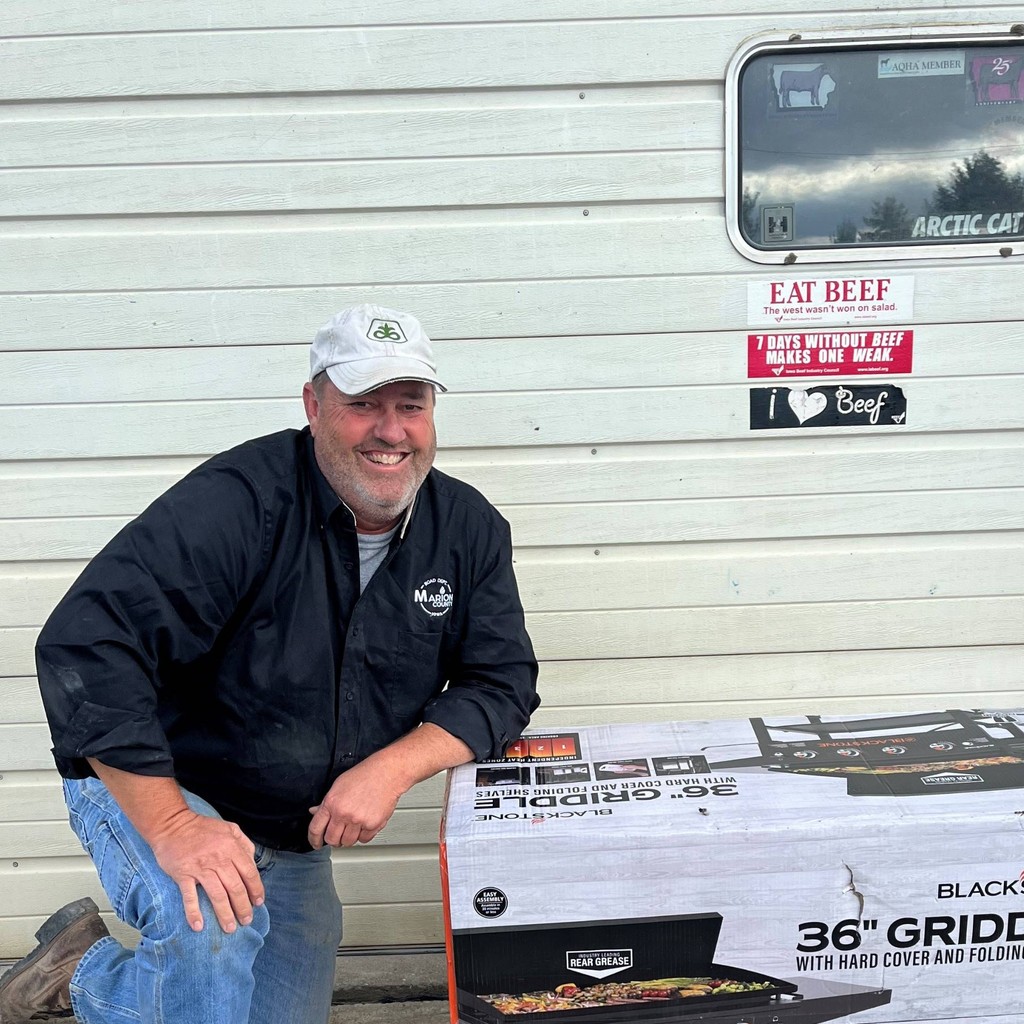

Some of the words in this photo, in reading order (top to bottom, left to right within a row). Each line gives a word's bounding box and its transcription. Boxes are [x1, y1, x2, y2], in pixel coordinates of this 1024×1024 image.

[892, 61, 919, 73] AQHA
[921, 60, 962, 70] MEMBER
[911, 213, 983, 238] ARCTIC
[986, 212, 1024, 235] CAT
[770, 281, 817, 305] EAT
[824, 279, 891, 303] BEEF
[763, 306, 780, 315] The
[782, 306, 804, 314] west
[805, 304, 835, 314] wasn't
[836, 305, 856, 313] won
[871, 303, 898, 312] salad.
[756, 335, 764, 350] 7
[767, 334, 801, 350] DAYS
[804, 333, 868, 349] WITHOUT
[871, 332, 905, 347] BEEF
[765, 350, 811, 365] MAKES
[818, 349, 845, 363] ONE
[852, 348, 894, 363] WEAK.
[835, 385, 889, 425] Beef
[817, 737, 904, 748] BLACKSTONE
[621, 780, 662, 789] COVER
[665, 778, 700, 786] HARD
[704, 776, 737, 784] WITH
[476, 788, 530, 798] SHELVES
[534, 786, 587, 796] FOLDING
[592, 783, 617, 792] AND
[474, 788, 662, 810] GRIDDLE
[475, 809, 613, 822] BLACKSTONE
[796, 918, 879, 953] 36"
[570, 957, 594, 967] REAR
[595, 956, 630, 966] GREASE
[796, 954, 833, 972] WITH
[839, 952, 879, 970] HARD
[883, 950, 930, 968] COVER
[934, 948, 965, 965] AND
